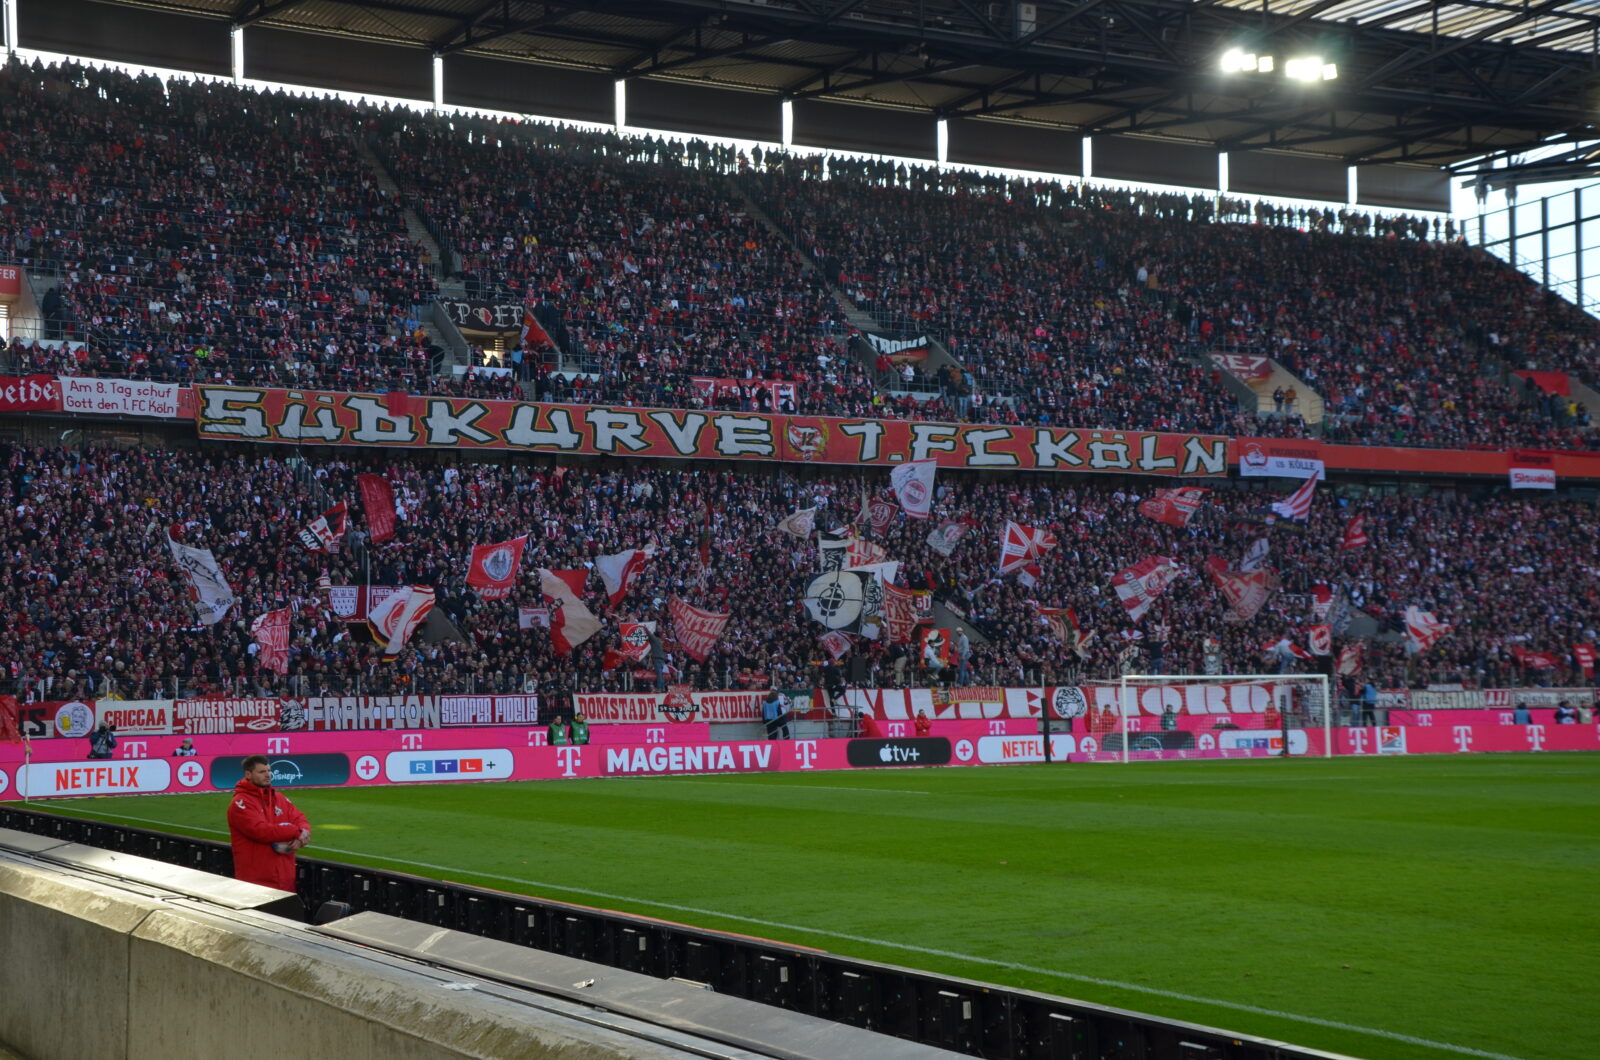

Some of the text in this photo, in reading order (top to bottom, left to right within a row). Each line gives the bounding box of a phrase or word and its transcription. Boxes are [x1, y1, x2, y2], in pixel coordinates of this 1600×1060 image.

[70, 380, 172, 398] Am 8. Tag schuf
[66, 396, 93, 409] Gott
[97, 398, 119, 410] den
[149, 400, 174, 414] Köln
[1033, 429, 1226, 475] KÖLN
[949, 686, 1000, 704] STADIONVERBOT
[104, 708, 167, 728] CRICCAA
[177, 699, 277, 719] MÜNGERSDORFER
[308, 695, 440, 730] FRAKTION
[441, 696, 538, 724] SEMPER FIDELIS
[577, 696, 657, 722] DOMSTADT
[184, 717, 235, 734] STADION
[607, 745, 772, 773] MAGENTA TV
[1002, 740, 1056, 759] NETFLX
[56, 766, 140, 791] NETFLIX
